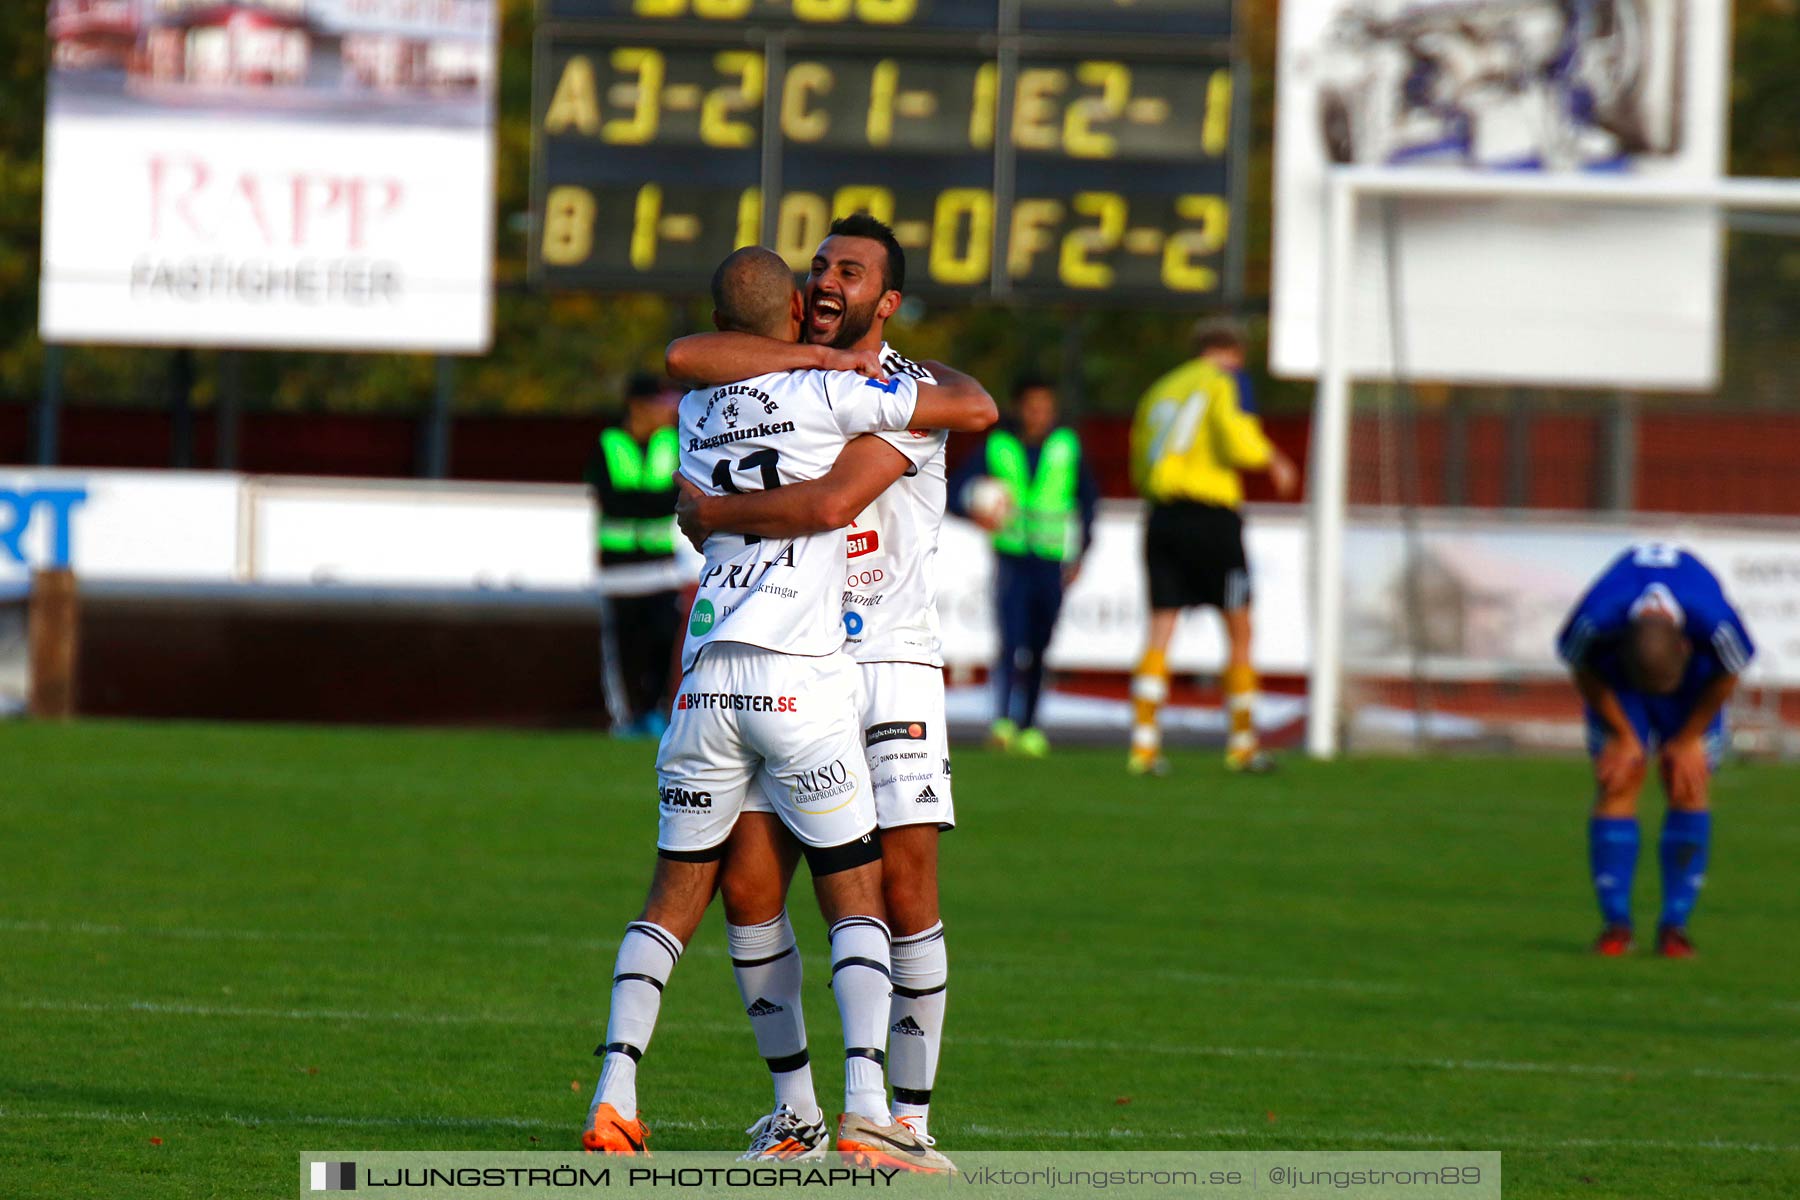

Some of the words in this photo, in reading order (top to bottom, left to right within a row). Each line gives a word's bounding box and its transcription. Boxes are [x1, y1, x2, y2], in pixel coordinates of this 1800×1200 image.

[696, 385, 779, 430] Restaurang
[753, 583, 799, 599] kringar
[793, 760, 847, 795] NISO
